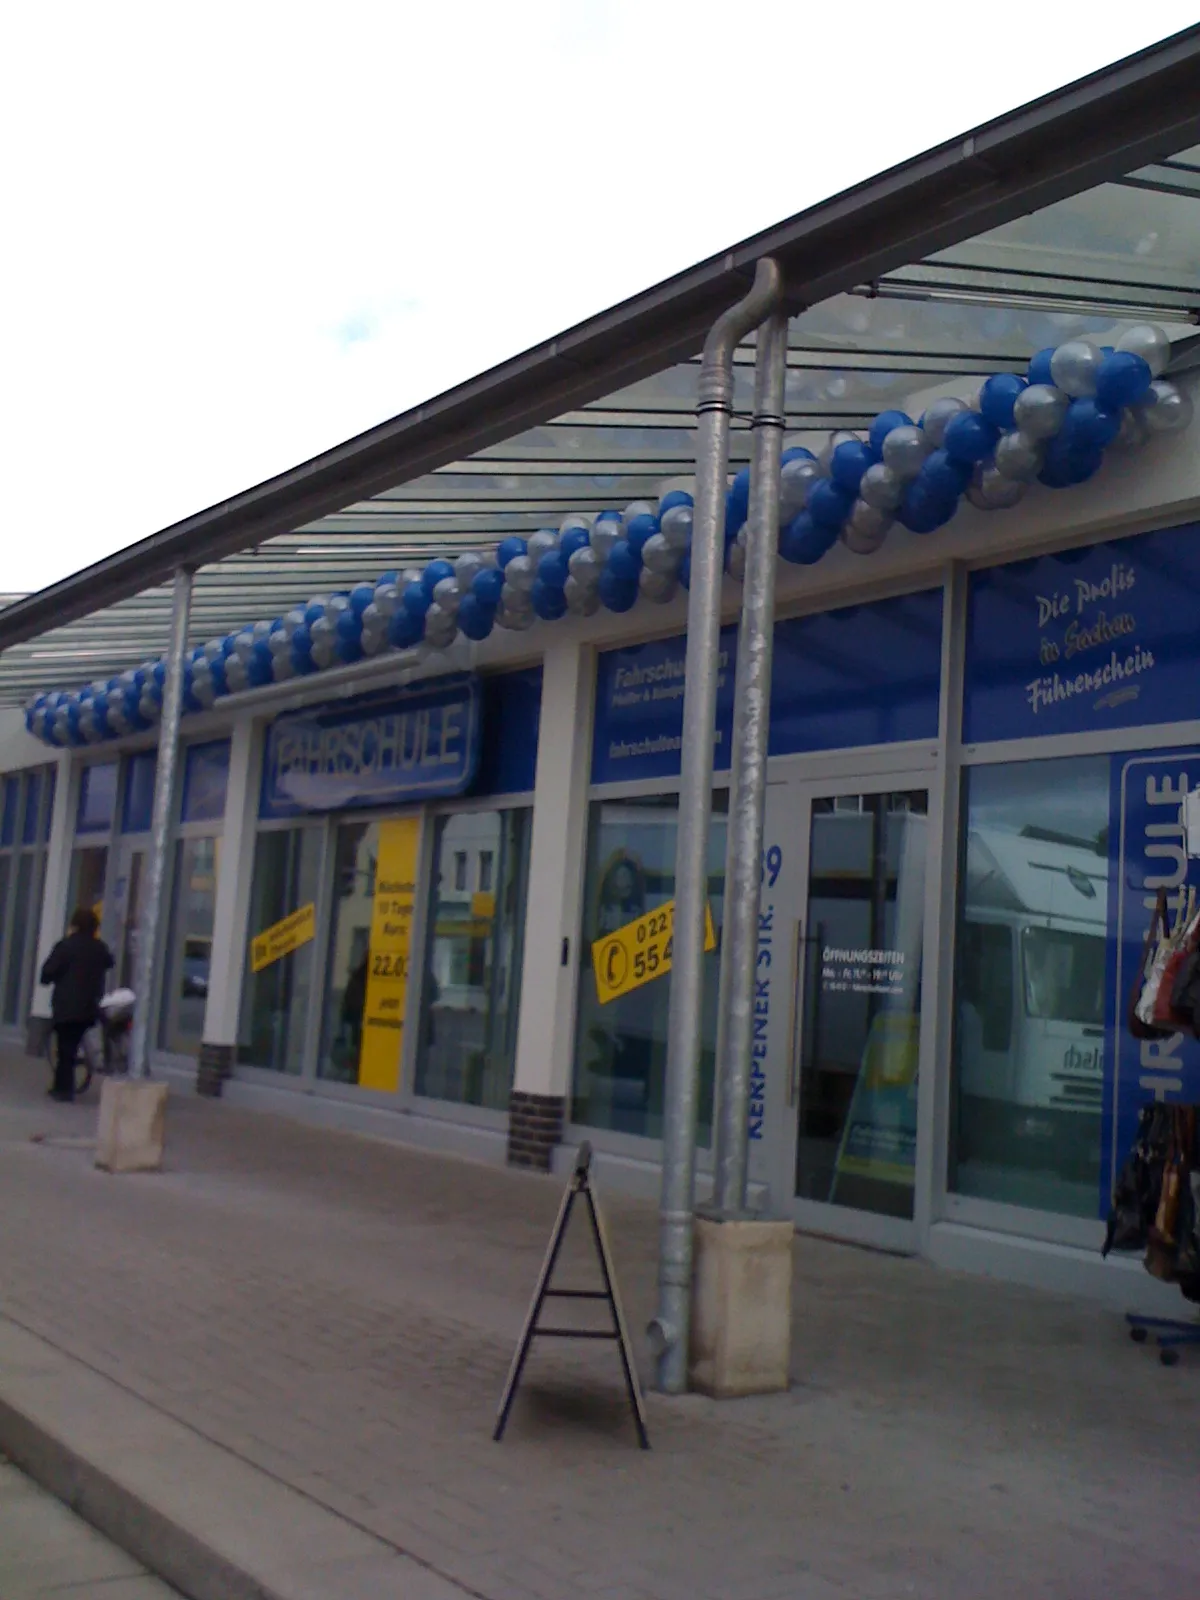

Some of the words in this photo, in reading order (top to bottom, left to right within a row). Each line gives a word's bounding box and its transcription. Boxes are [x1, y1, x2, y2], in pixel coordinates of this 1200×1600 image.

[1035, 591, 1070, 627] Die
[1074, 563, 1136, 614] Profis
[1040, 637, 1061, 666] in
[1065, 610, 1137, 660] Sachen
[1026, 644, 1155, 714] Führerschein
[278, 703, 464, 778] FAHRSCHULE
